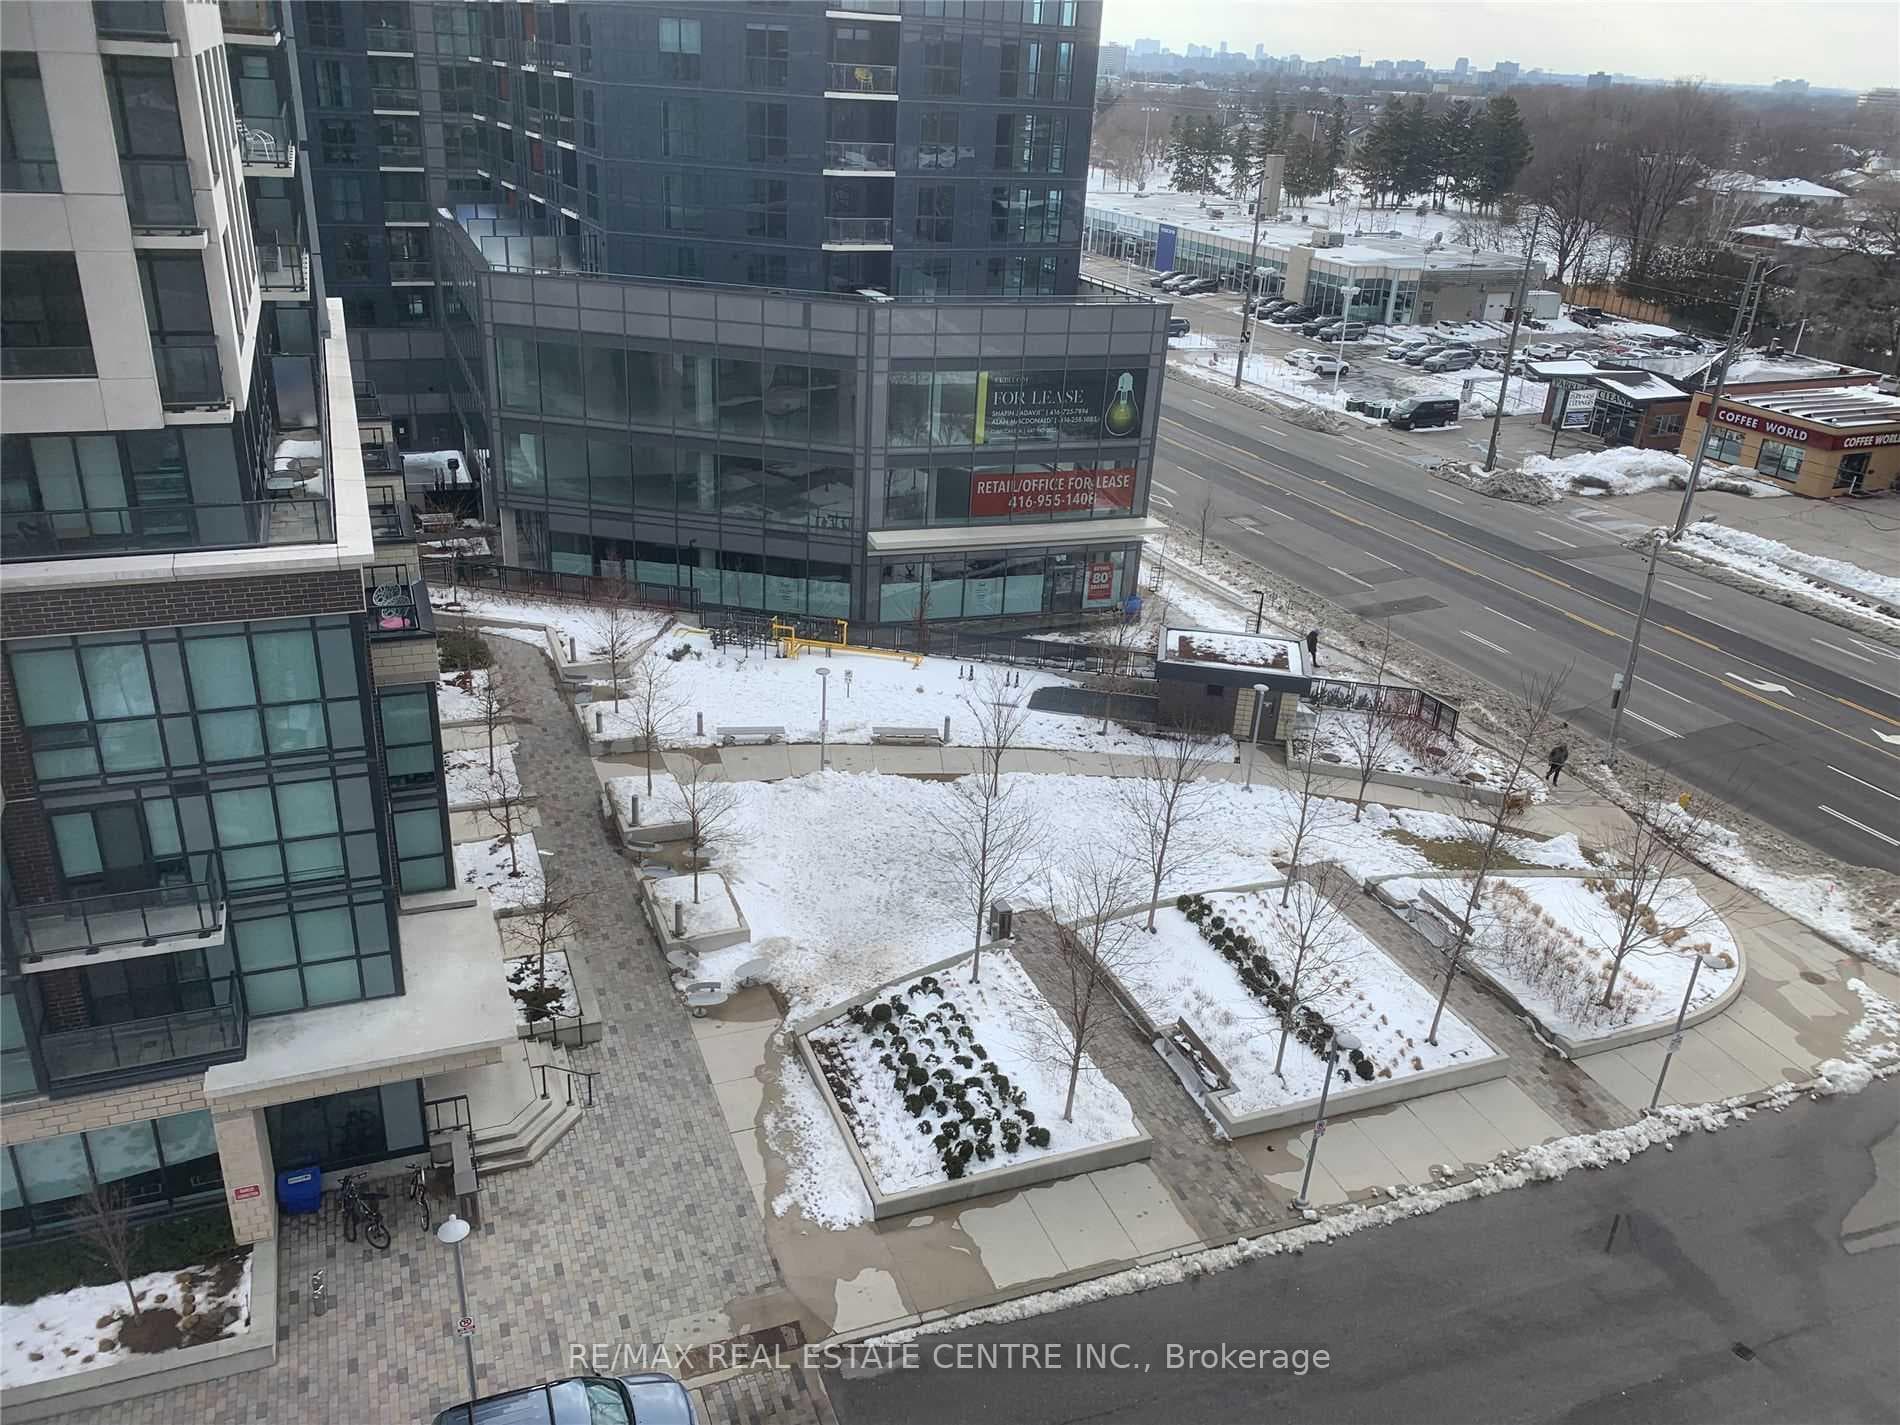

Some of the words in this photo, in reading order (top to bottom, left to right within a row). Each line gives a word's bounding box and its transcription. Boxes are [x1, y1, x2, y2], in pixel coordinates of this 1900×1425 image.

[994, 391, 1025, 405] FOR
[1032, 389, 1084, 405] LEASE
[1718, 410, 1759, 429] COFFEE
[1765, 421, 1808, 441] WORLD
[1843, 435, 1874, 448] COFFEE
[977, 478, 1065, 494] RETAIL/OFFICE
[1068, 476, 1093, 490] FOR
[1096, 475, 1130, 489] LEASE
